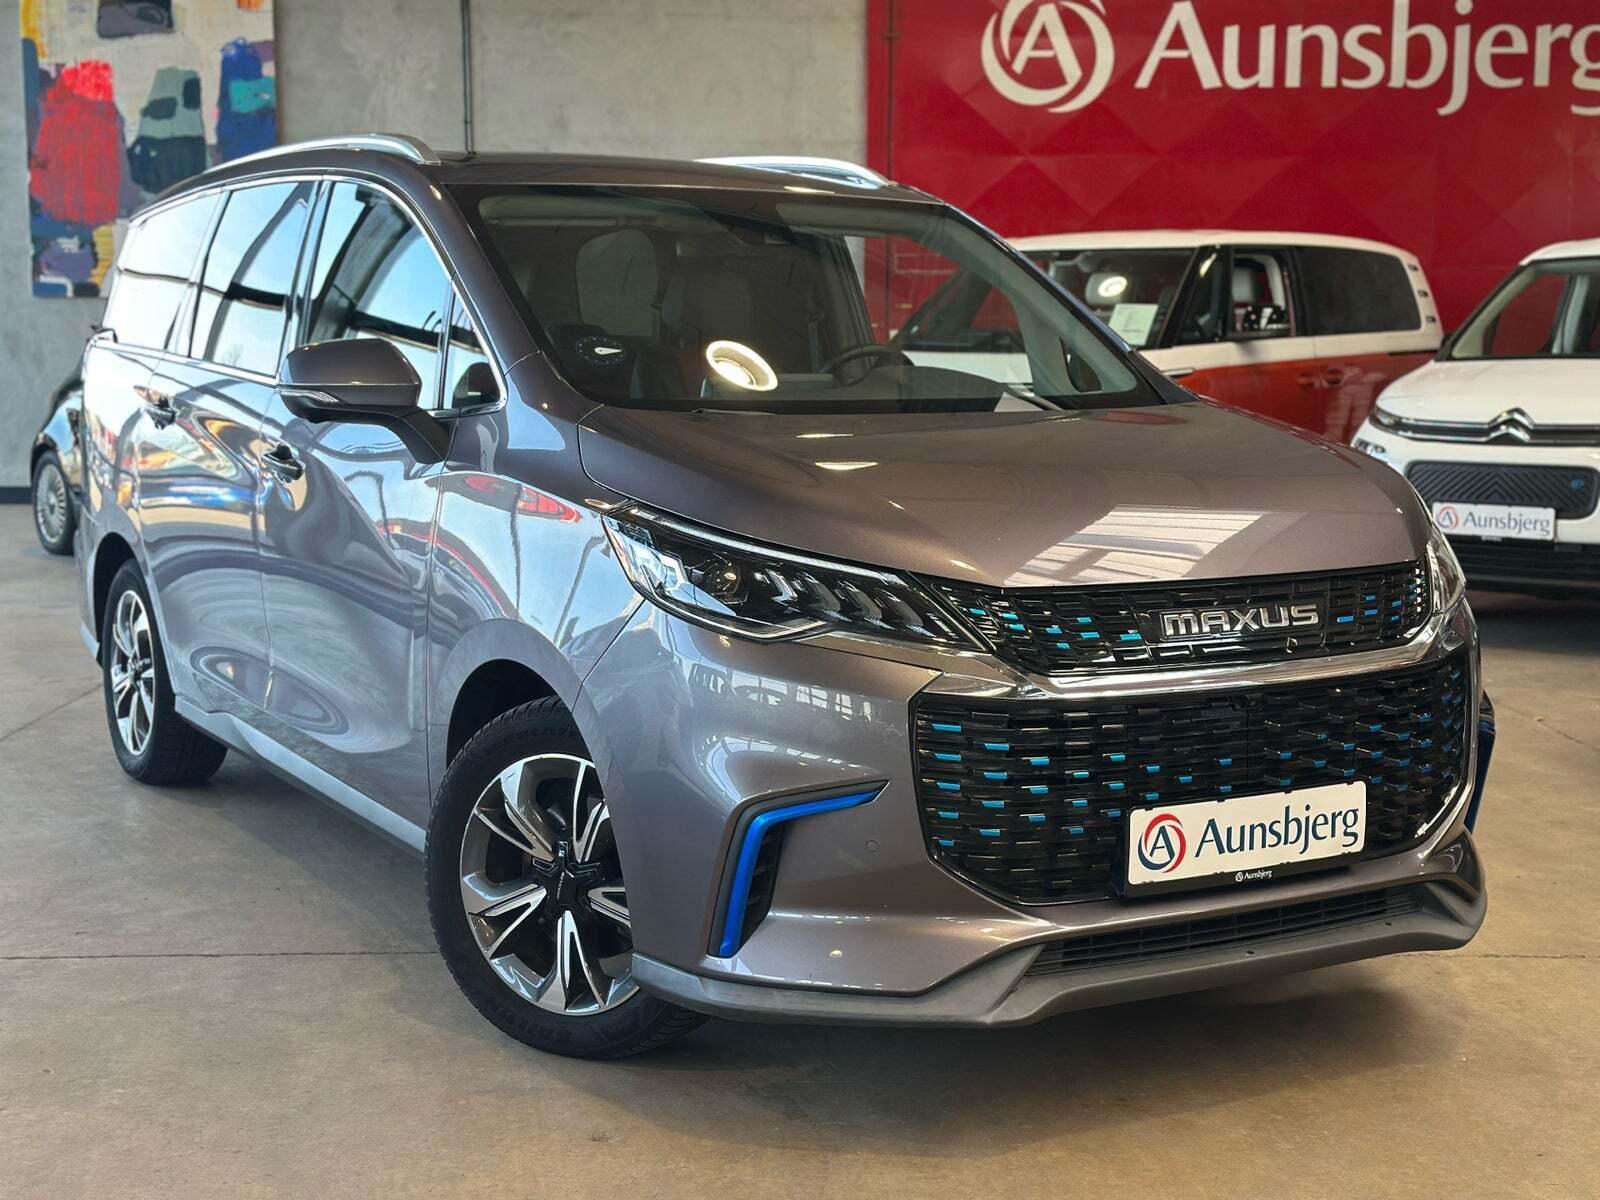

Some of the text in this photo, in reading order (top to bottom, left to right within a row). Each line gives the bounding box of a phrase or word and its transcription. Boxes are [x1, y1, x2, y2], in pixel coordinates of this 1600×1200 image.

[1463, 511, 1551, 537] Aunsbjerg
[1165, 604, 1319, 636] MAXUS
[1195, 804, 1360, 857] Aunsbjerg
